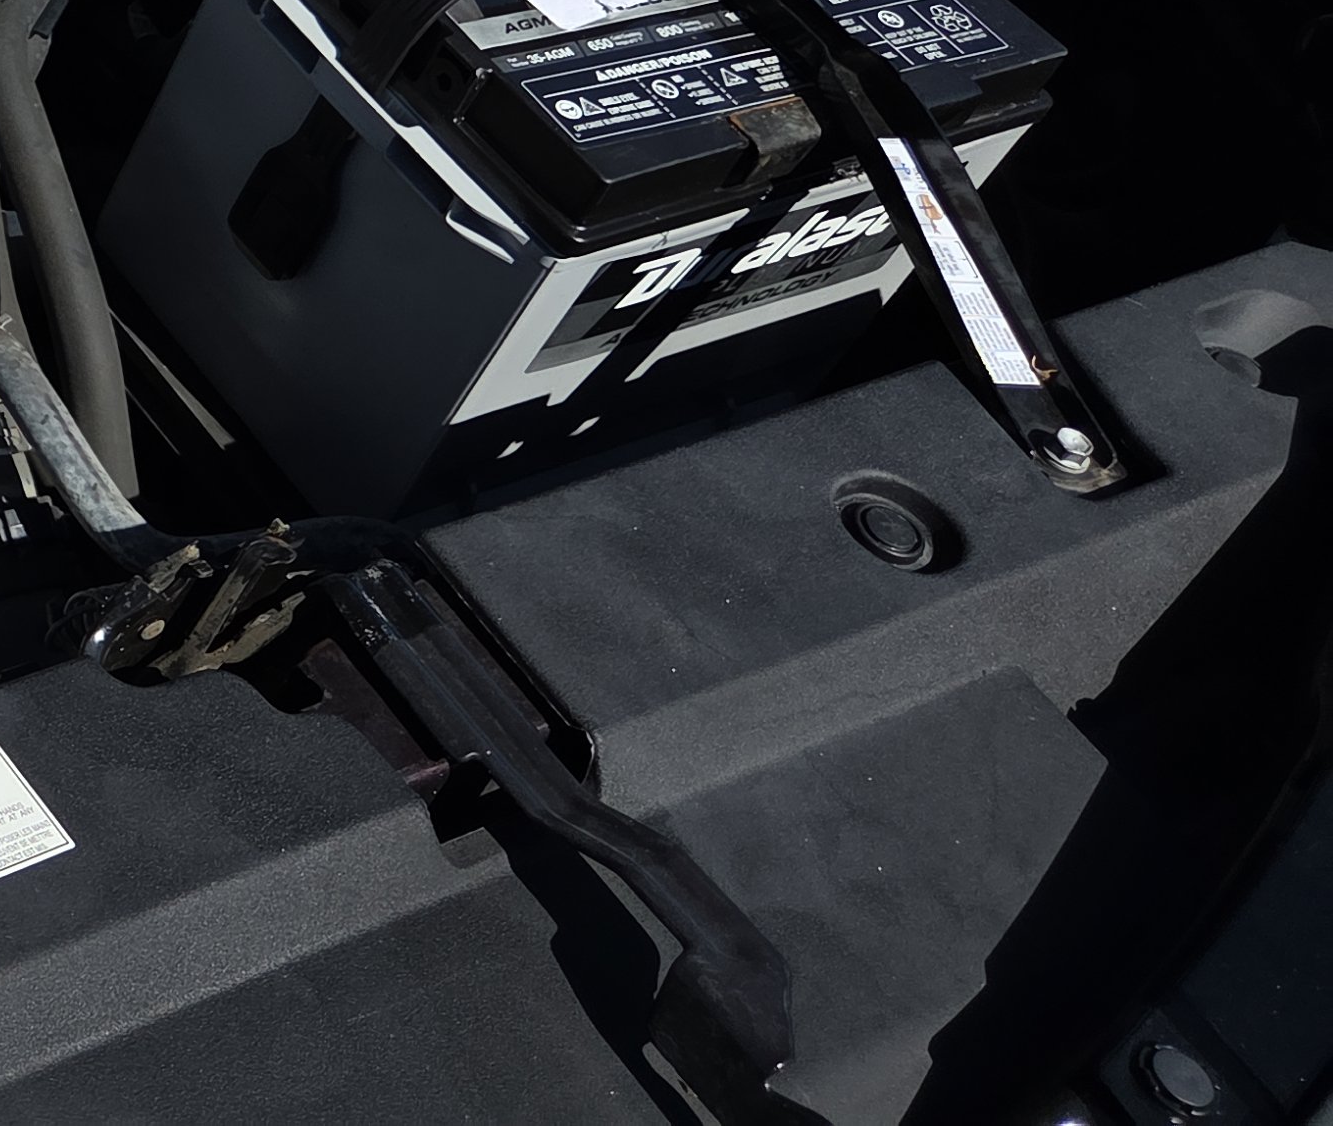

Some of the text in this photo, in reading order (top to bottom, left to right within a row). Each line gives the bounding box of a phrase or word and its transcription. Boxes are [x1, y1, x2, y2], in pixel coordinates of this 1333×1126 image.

[505, 15, 552, 34] AGM
[656, 24, 683, 38] 800
[587, 37, 614, 51] 650
[526, 46, 575, 64] 35-AGM
[686, 269, 840, 321] ECHNOLOGY
[6, 812, 19, 821] AT
[17, 806, 35, 817] ANY
